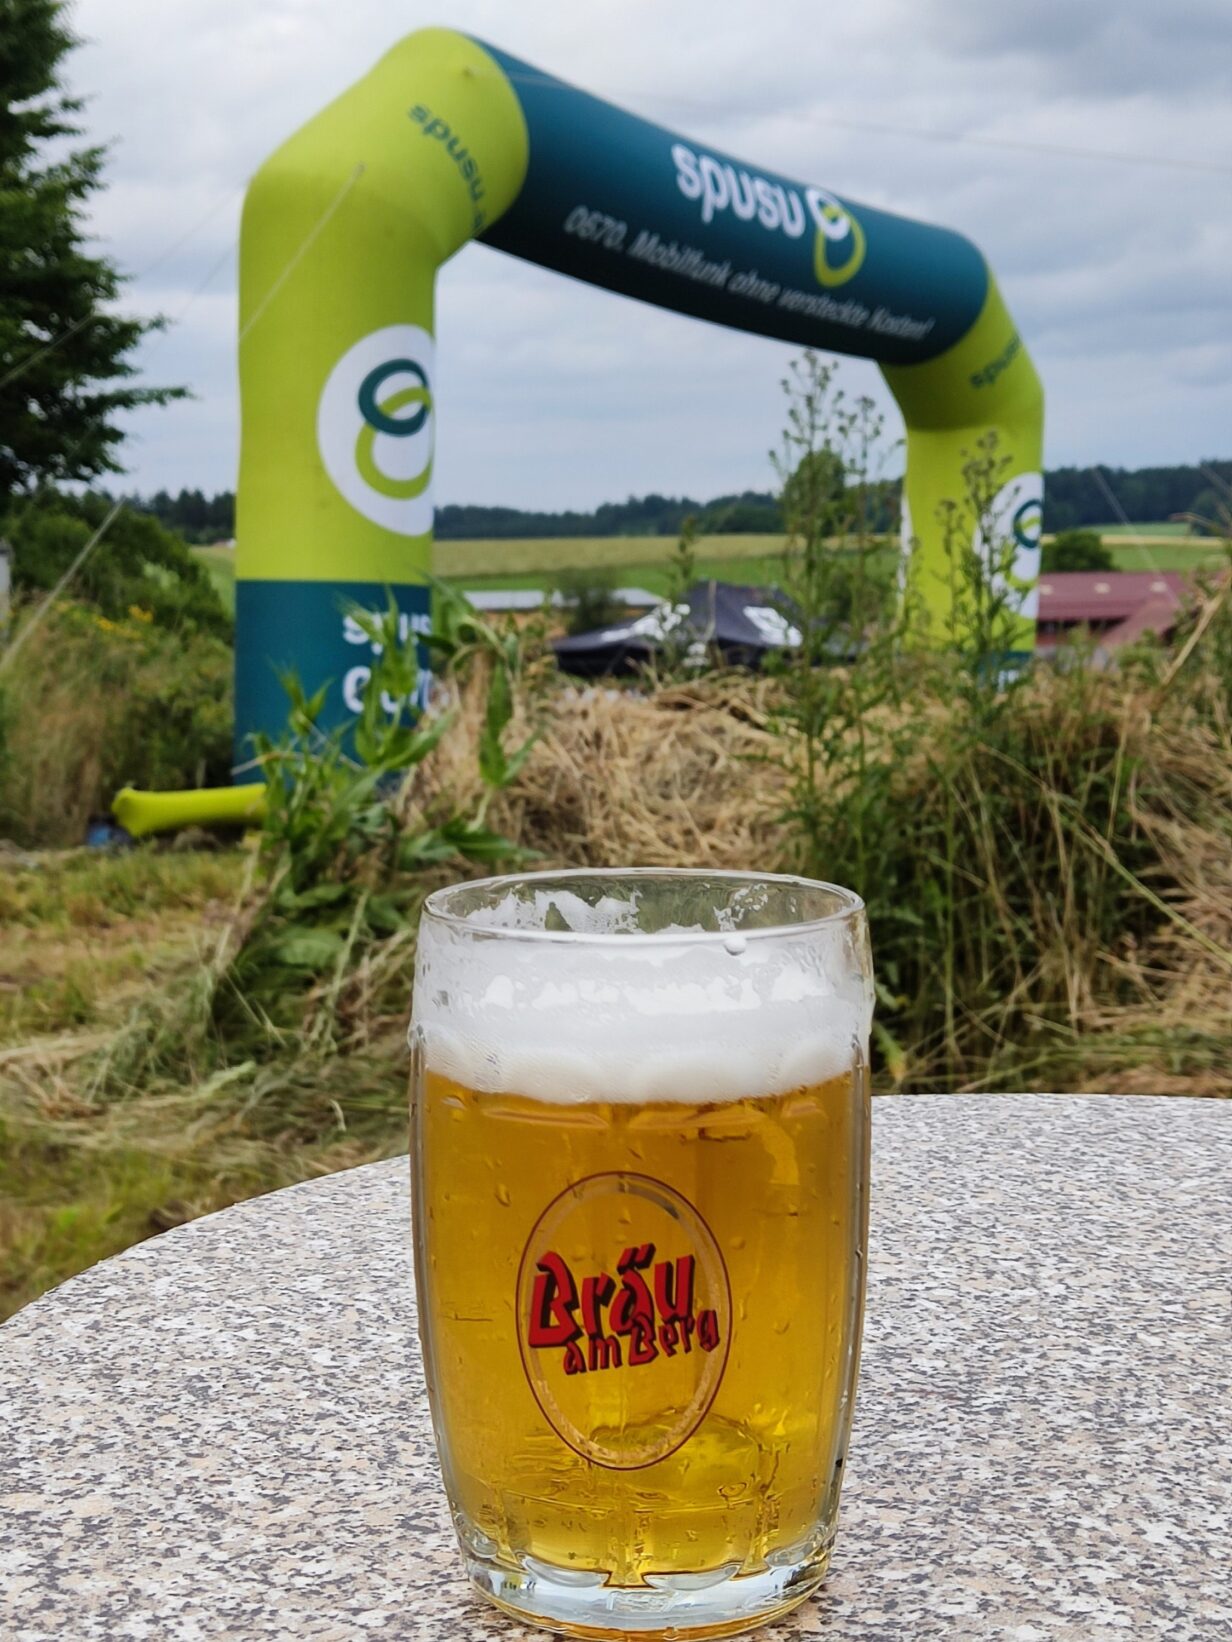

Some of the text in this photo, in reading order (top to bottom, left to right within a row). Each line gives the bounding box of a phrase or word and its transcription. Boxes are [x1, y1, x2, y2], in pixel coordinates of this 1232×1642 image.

[408, 104, 485, 203] spusu
[671, 143, 806, 239] spusu
[727, 270, 782, 304] ohne
[528, 1243, 695, 1348] Bräu
[563, 1309, 720, 1375] am Berg
